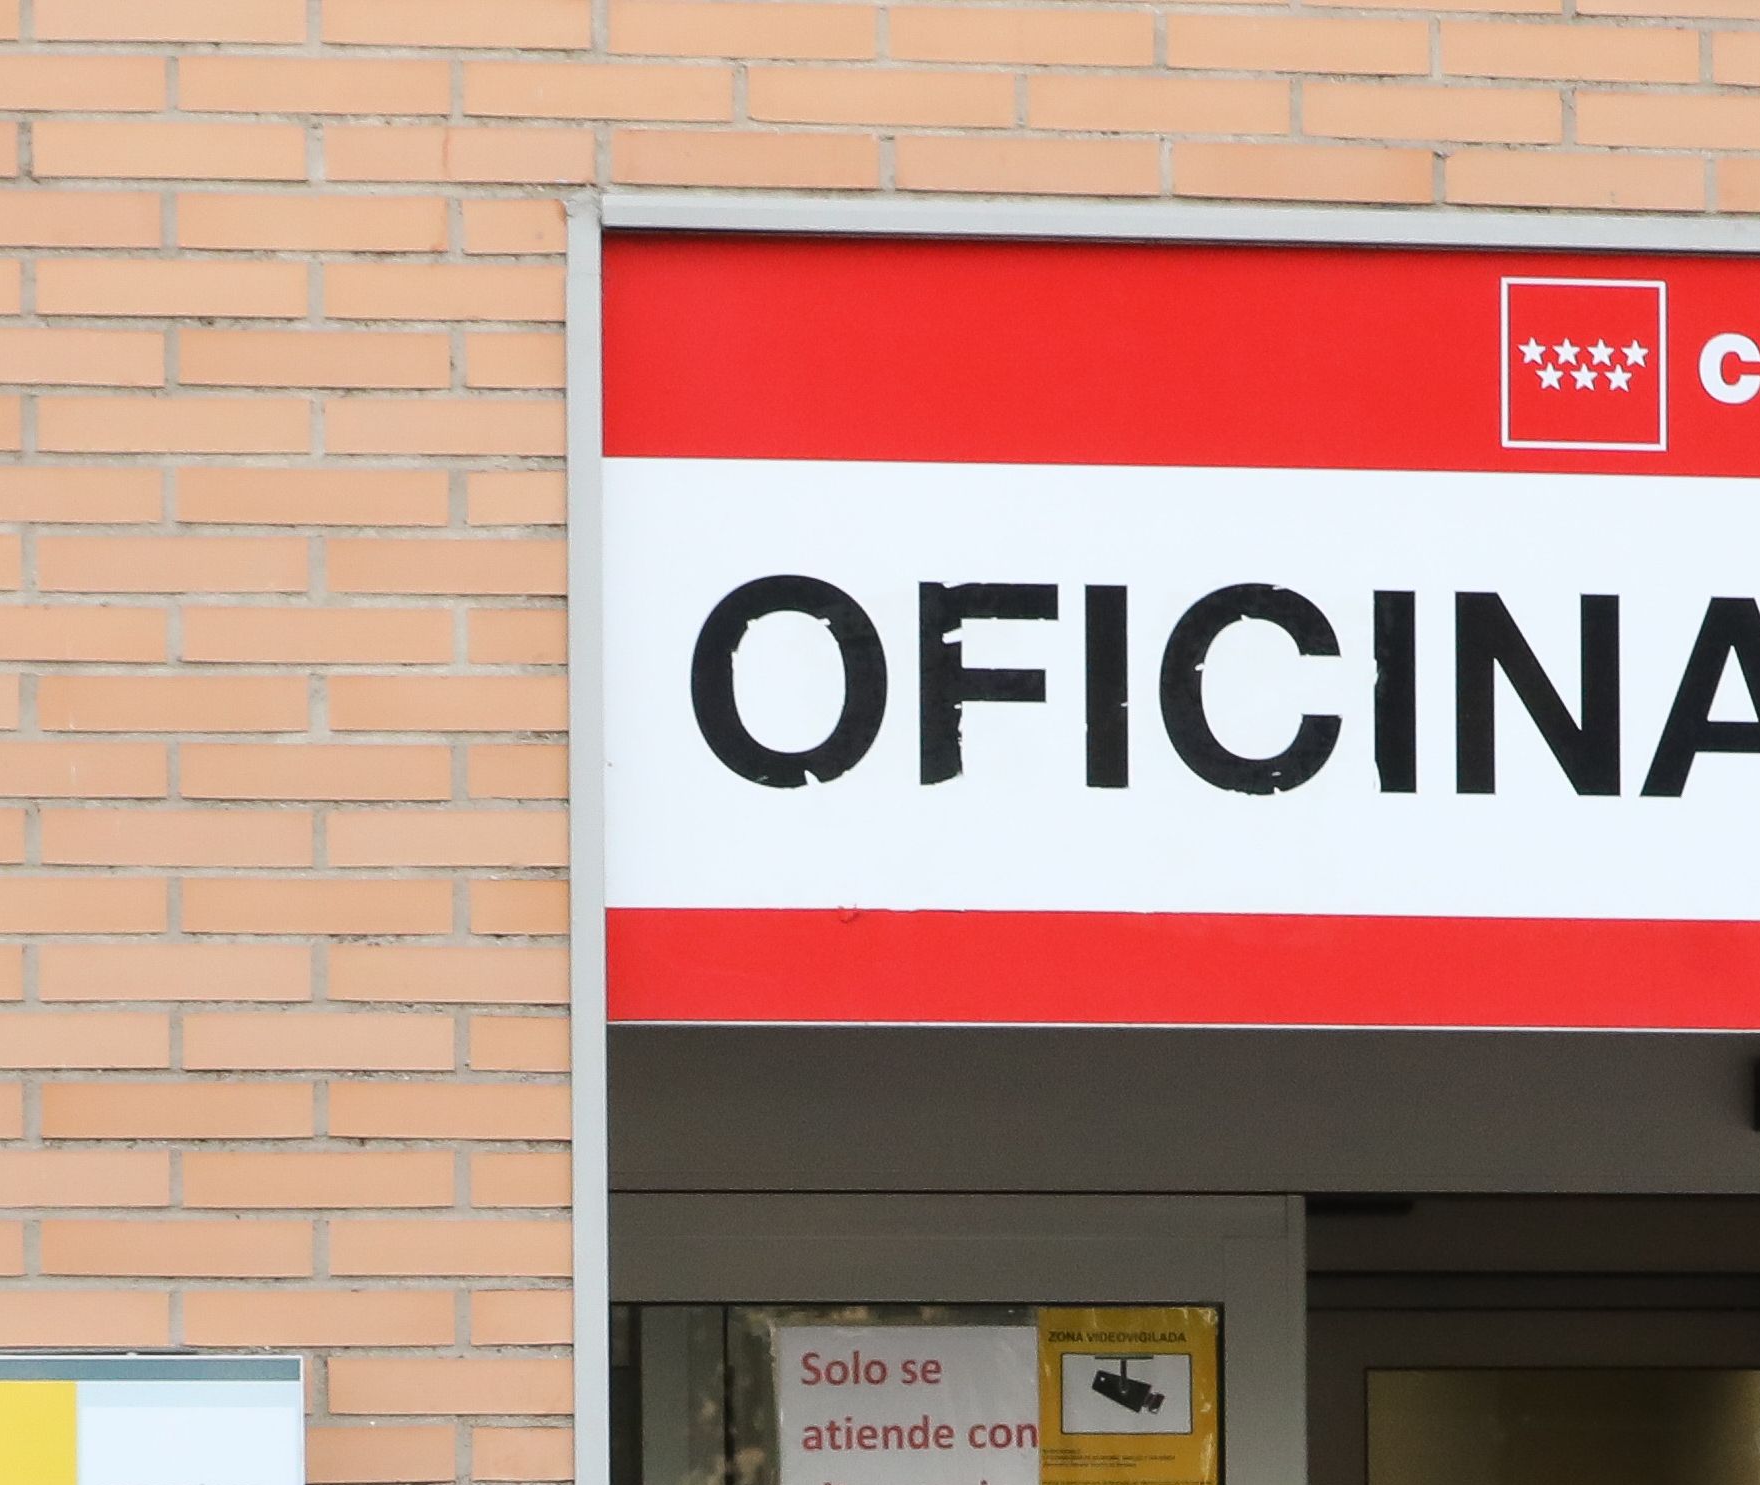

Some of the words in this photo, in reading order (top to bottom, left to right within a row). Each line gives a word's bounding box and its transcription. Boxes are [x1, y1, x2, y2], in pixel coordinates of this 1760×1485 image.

[1048, 1331, 1083, 1343] ZONA
[1087, 1331, 1186, 1343] VIDEOVIGILADA
[801, 1351, 887, 1386] Solo
[901, 1359, 942, 1385] se
[803, 1416, 954, 1451] atiende
[969, 1423, 1039, 1450] con
